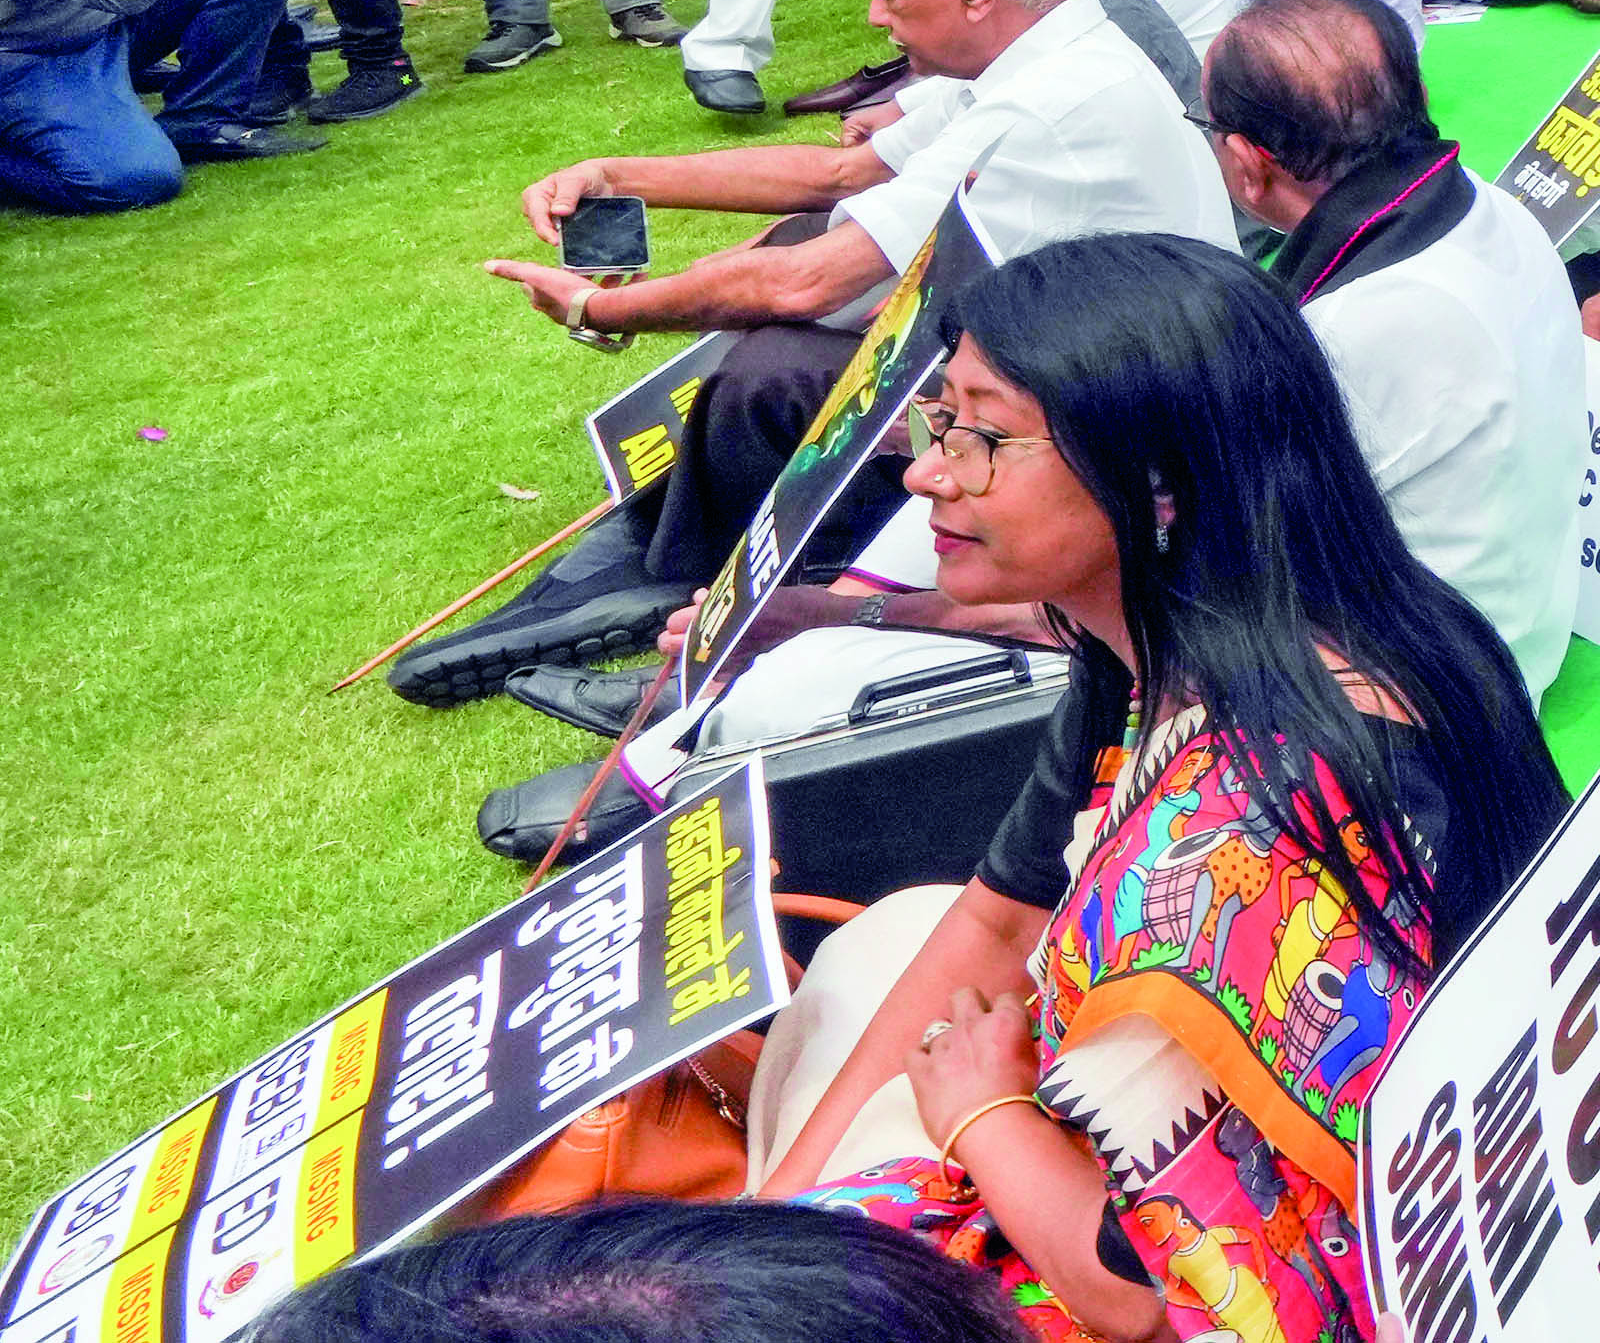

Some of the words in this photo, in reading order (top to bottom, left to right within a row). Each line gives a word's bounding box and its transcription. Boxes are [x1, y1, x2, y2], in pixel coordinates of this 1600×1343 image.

[505, 842, 644, 1054] गुमशुदा
[241, 1039, 316, 1138] SEBI
[331, 1021, 369, 1102] MISSING
[537, 1021, 634, 1112] की
[57, 1165, 137, 1249] CBI
[147, 1128, 199, 1214] MISSING
[306, 1145, 344, 1243] MISSING
[1471, 1017, 1564, 1330] ADANI
[211, 1176, 281, 1255] ED
[116, 1262, 156, 1343] MISSIN
